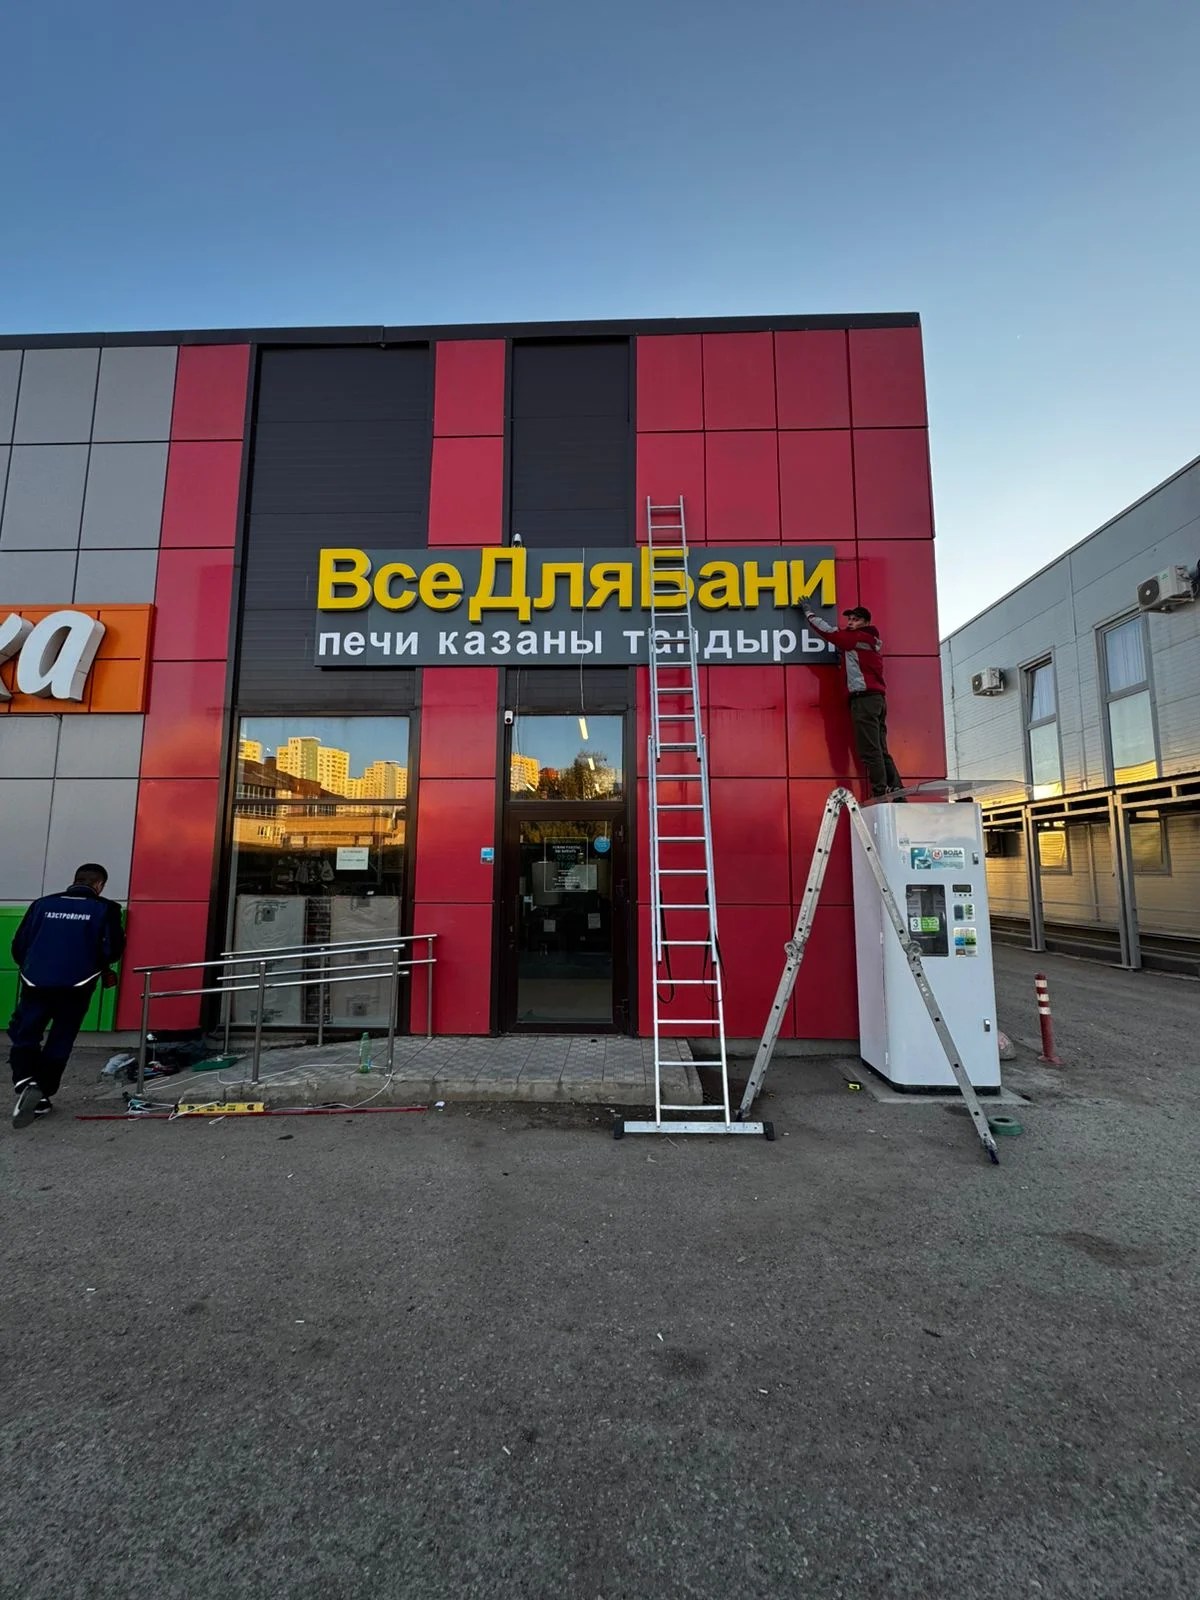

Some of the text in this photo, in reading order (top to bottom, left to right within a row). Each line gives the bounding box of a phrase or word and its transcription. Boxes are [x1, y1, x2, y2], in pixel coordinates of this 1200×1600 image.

[317, 546, 836, 623] ВсеДляБани
[318, 631, 419, 656] печи
[438, 629, 603, 656] казаны
